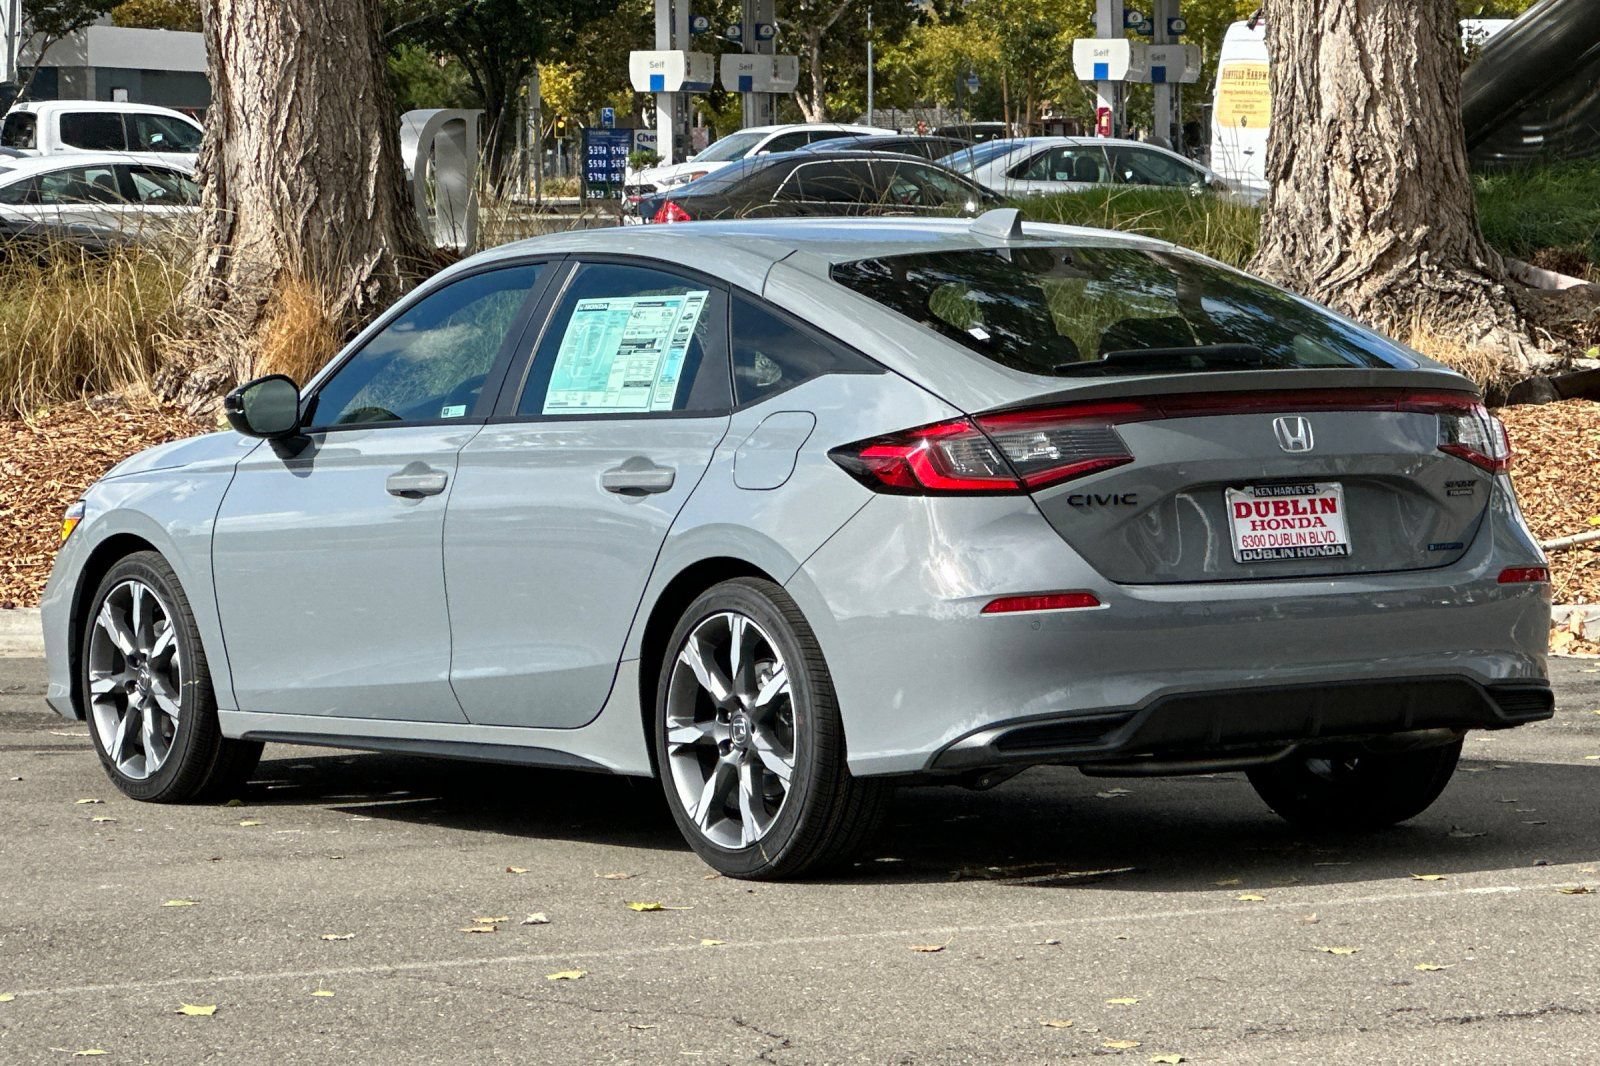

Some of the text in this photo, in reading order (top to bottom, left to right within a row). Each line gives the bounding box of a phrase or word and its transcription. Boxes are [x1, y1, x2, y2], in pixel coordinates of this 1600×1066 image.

[698, 19, 704, 27] 2
[731, 27, 737, 35] 3
[1093, 48, 1109, 57] Self
[1151, 53, 1166, 61] Self
[649, 61, 665, 69] Self
[738, 63, 753, 71] Self
[1255, 485, 1315, 497] KEN HARVEY'S
[1067, 493, 1138, 506] CIVIC
[1234, 497, 1337, 519] DUBLIN
[1250, 516, 1327, 532] HONDA
[1242, 530, 1339, 548] 6300 DUBLIN BLVD.
[1243, 545, 1345, 561] DUBLIN HONDA
